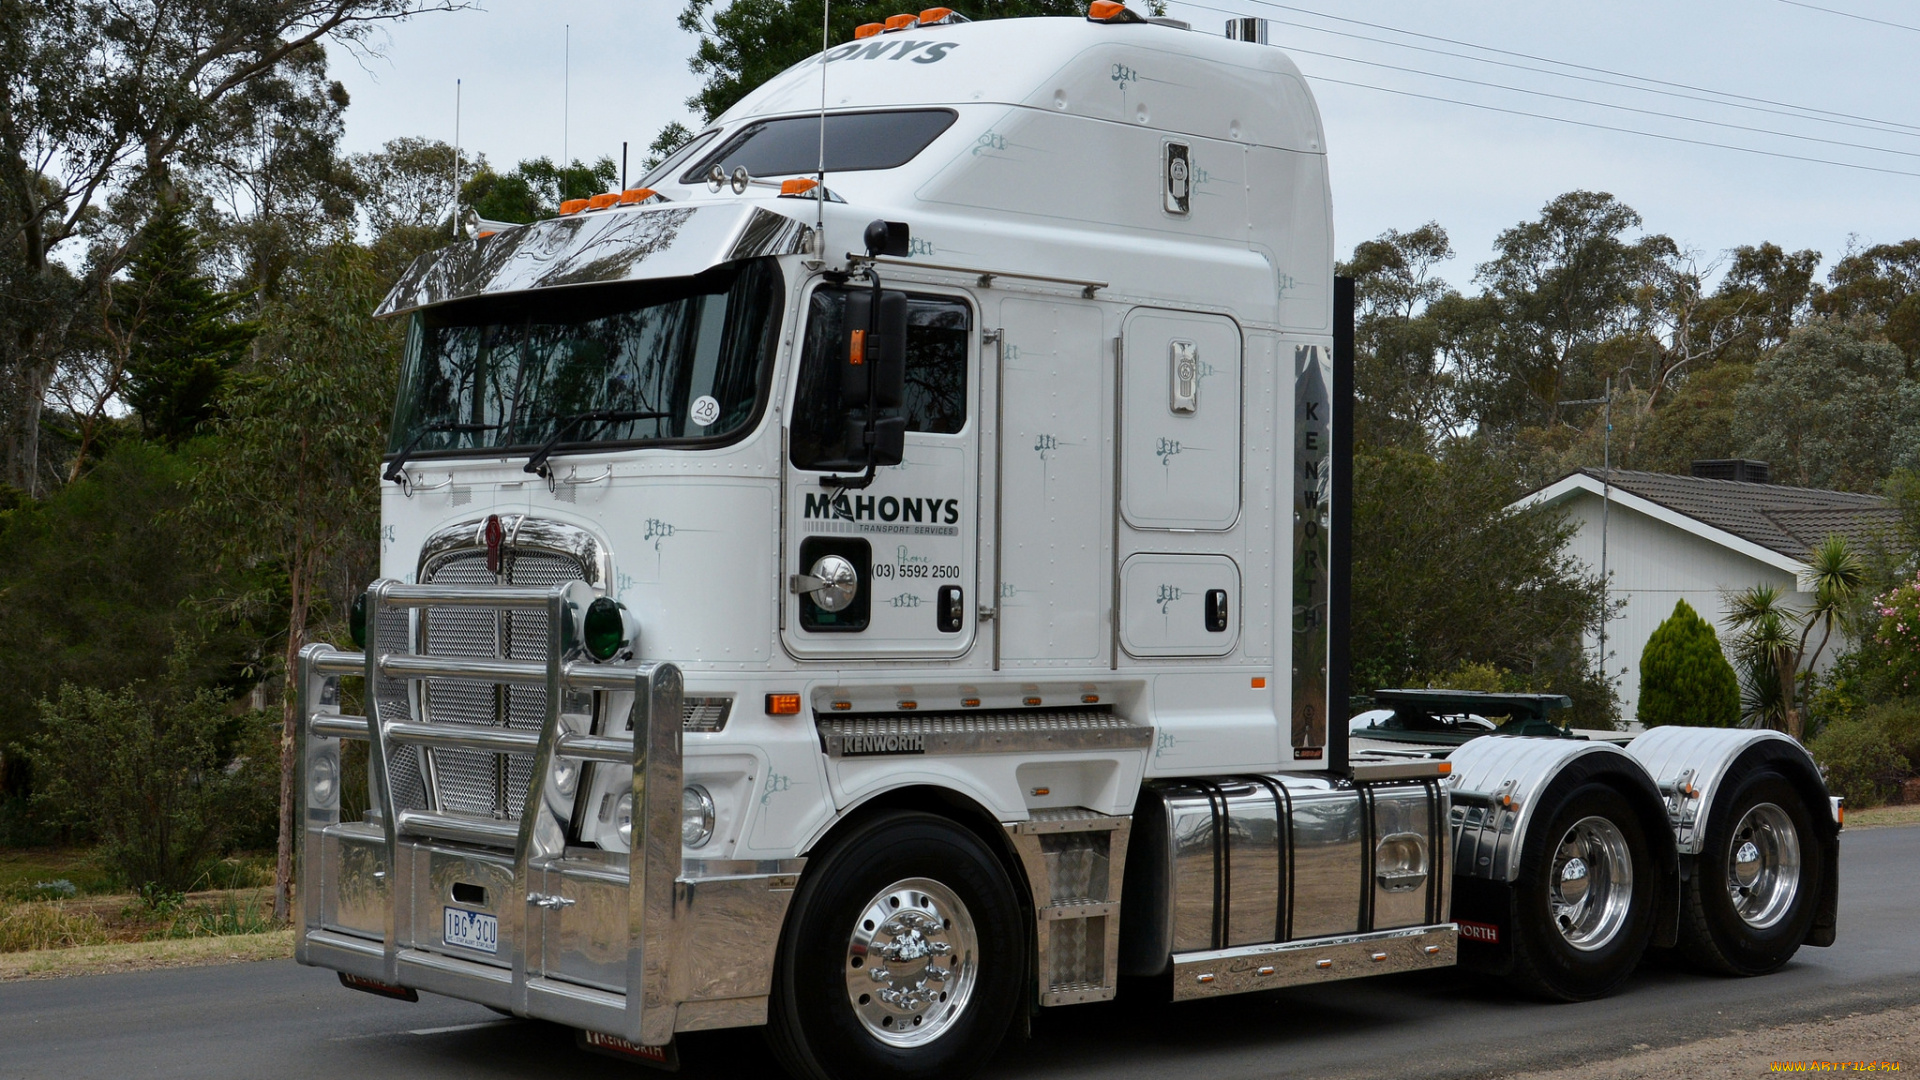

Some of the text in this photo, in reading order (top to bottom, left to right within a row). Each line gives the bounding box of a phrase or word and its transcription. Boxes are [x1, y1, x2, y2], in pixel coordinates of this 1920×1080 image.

[696, 400, 714, 416] 28
[804, 492, 959, 524] MAHONYS
[1304, 402, 1319, 627] KENWORTH
[859, 524, 953, 535] TRANSPORT SERVICES
[897, 545, 932, 566] Phone
[871, 563, 960, 580] (03) 5592 2500
[844, 735, 925, 753] KENWORTH
[448, 913, 496, 943] 1BG 3CU
